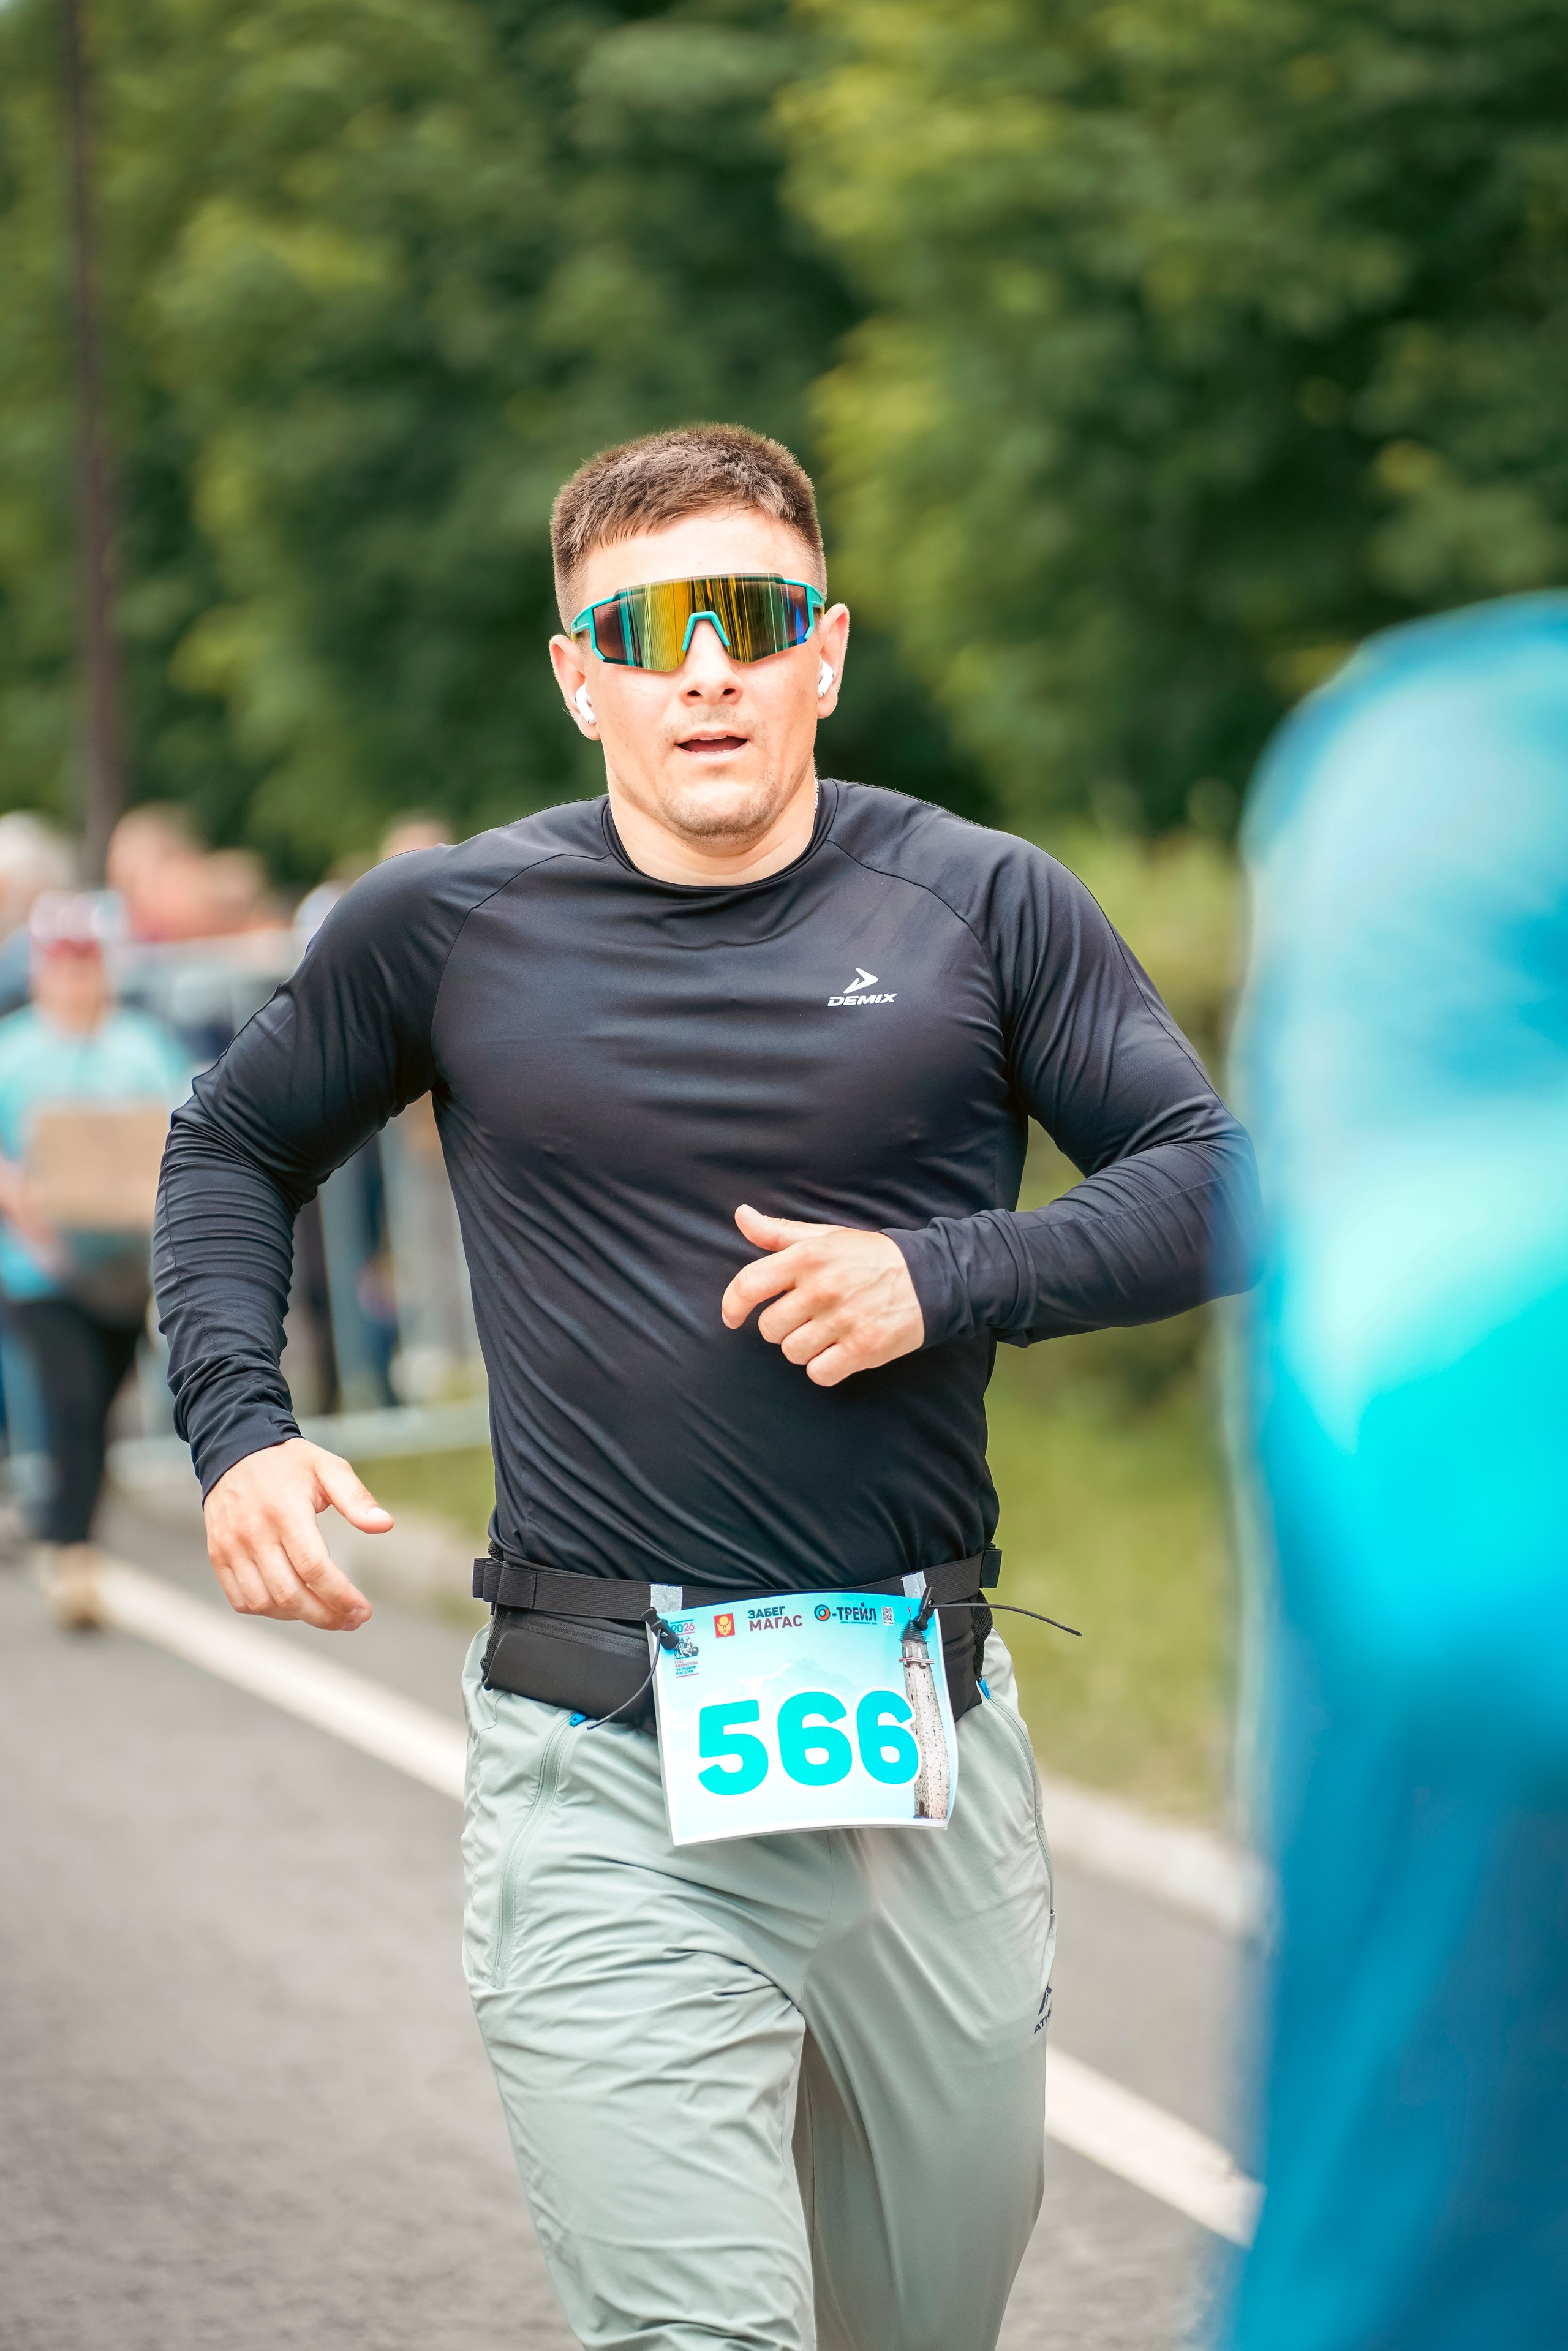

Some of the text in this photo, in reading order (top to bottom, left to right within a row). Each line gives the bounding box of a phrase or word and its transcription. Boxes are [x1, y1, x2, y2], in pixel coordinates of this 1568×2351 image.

[827, 994, 897, 1006] DEMIX
[747, 1606, 785, 1619] ЗАБЕГ
[671, 1622, 695, 1632] 2026
[749, 1615, 802, 1632] МАГАС
[698, 1690, 919, 1795] 566
